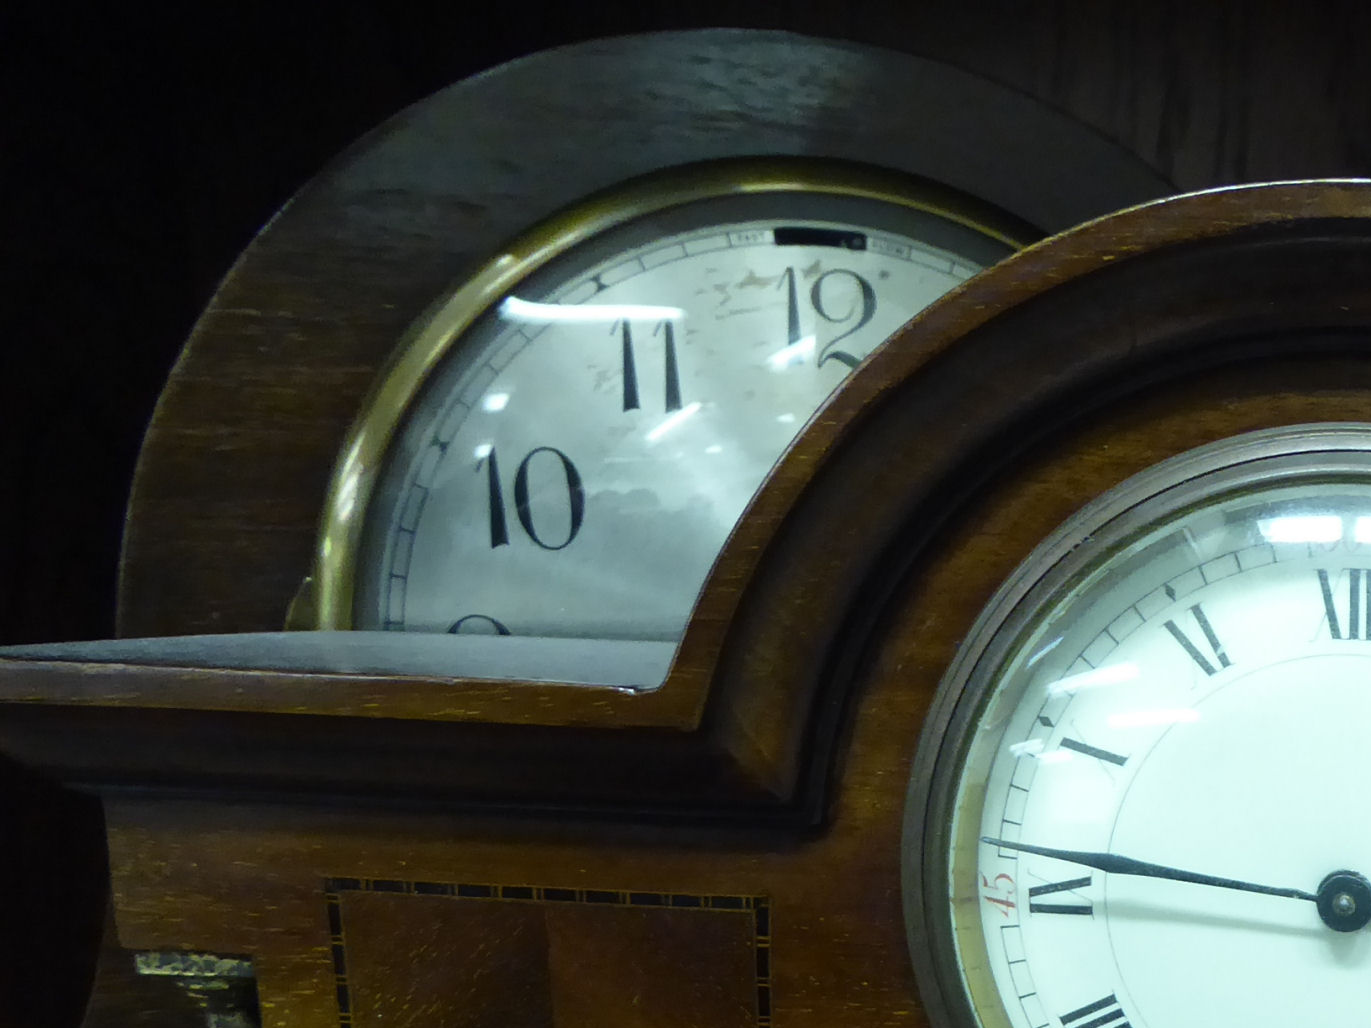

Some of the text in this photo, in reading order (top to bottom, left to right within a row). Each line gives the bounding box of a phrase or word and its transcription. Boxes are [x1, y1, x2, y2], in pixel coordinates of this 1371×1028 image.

[778, 266, 877, 369] 12
[609, 318, 683, 413] 11
[475, 444, 586, 550] 10
[1163, 603, 1238, 691] XI
[1060, 719, 1132, 786] X
[981, 871, 1016, 918] 45
[1026, 866, 1095, 920] IX
